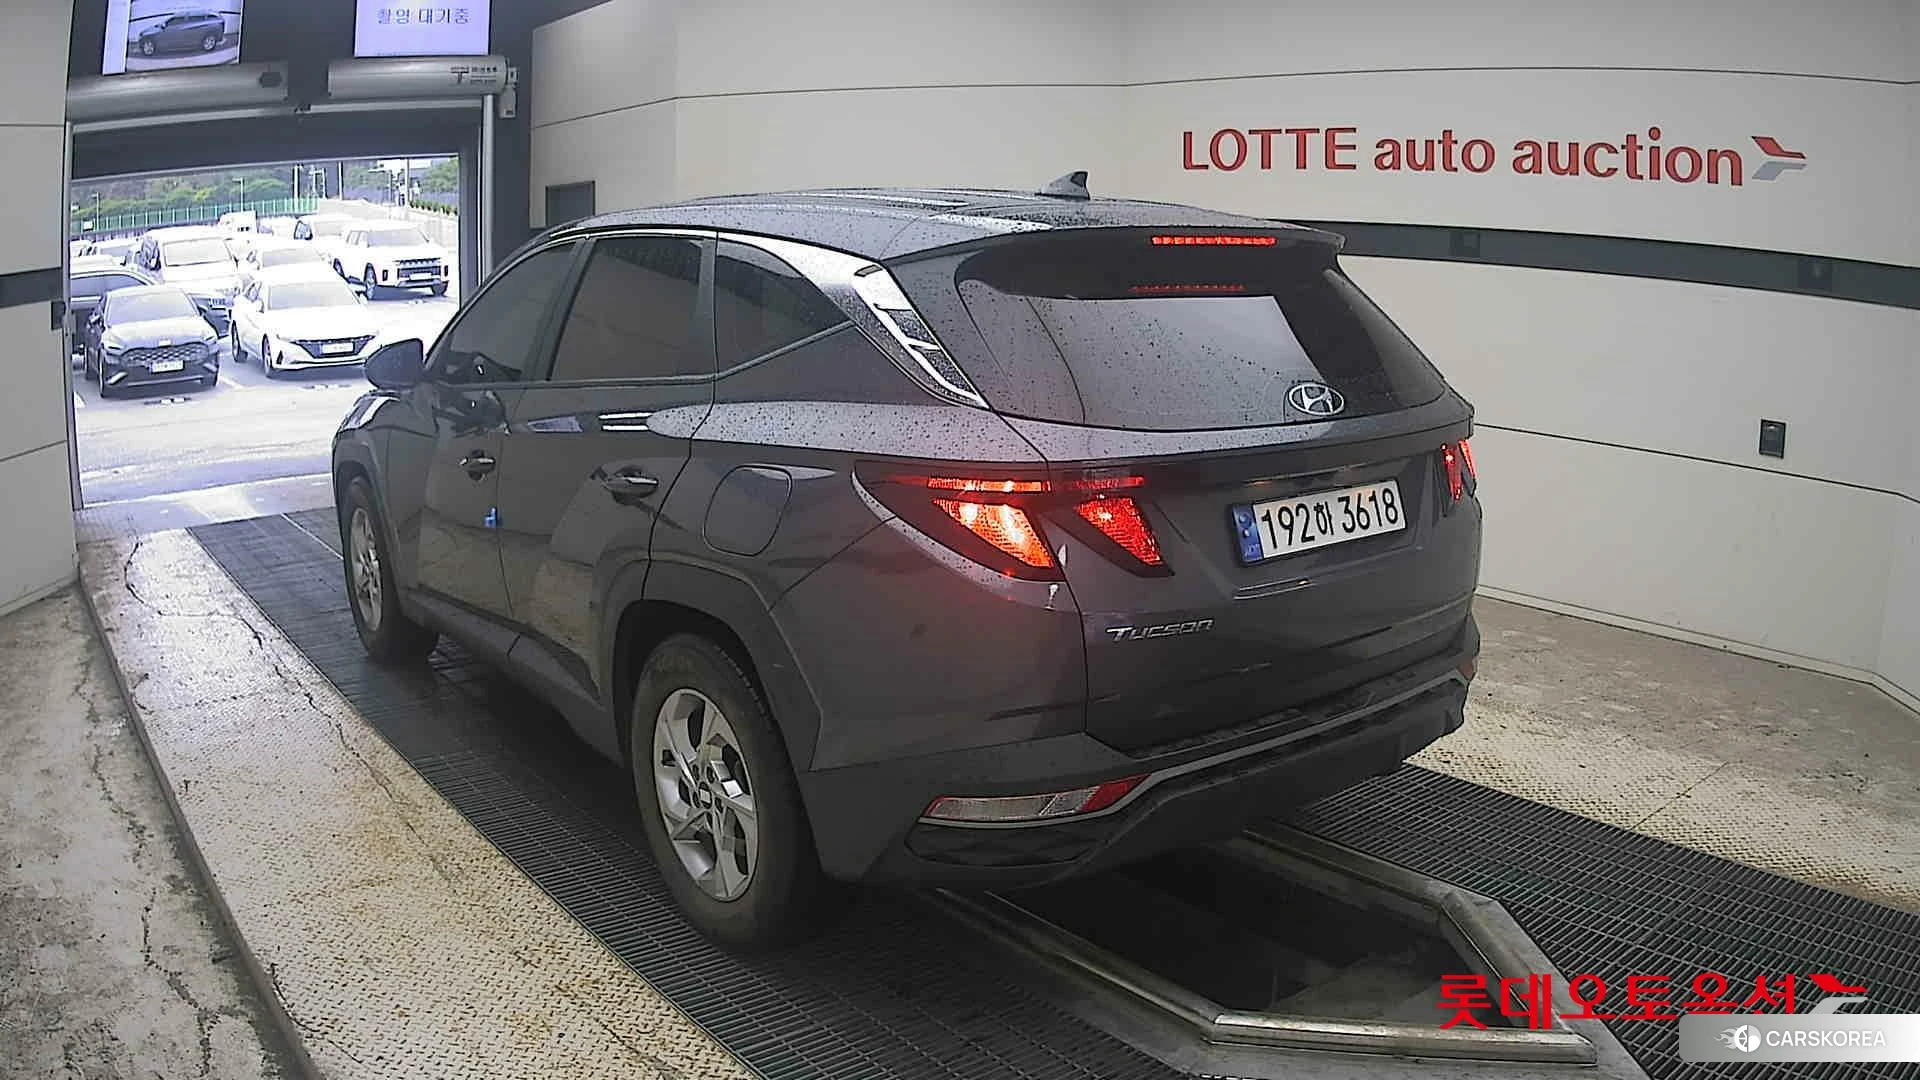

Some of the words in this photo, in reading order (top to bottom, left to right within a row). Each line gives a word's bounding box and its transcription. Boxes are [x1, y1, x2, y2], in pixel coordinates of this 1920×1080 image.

[418, 8, 470, 24] 대기중
[1183, 128, 1357, 171] LOTTE
[1374, 130, 1496, 173] auto
[1512, 127, 1744, 186] auction
[1261, 503, 1335, 549] 192하
[1337, 488, 1398, 534] 3618
